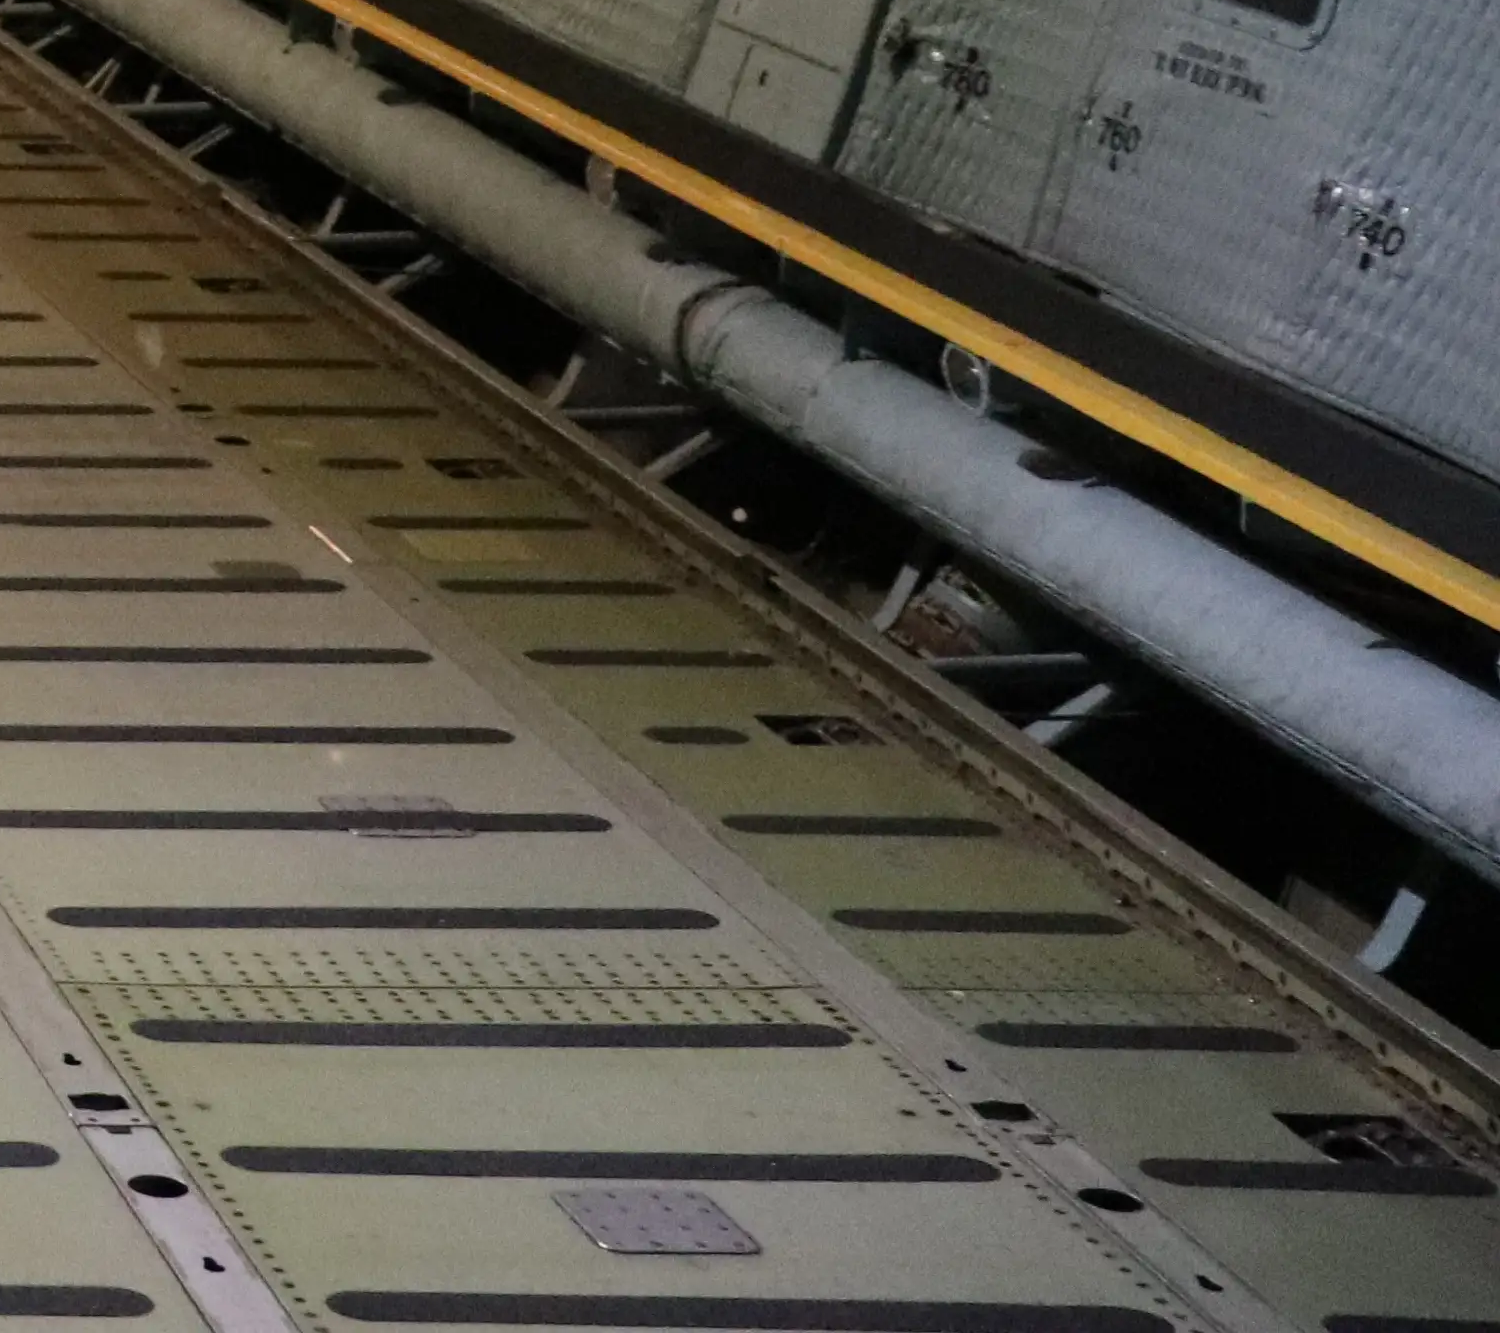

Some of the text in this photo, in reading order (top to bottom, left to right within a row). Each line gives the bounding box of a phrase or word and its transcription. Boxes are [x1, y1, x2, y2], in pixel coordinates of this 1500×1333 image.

[939, 61, 991, 100] 780
[1096, 114, 1142, 155] 760
[1347, 206, 1405, 257] 740
